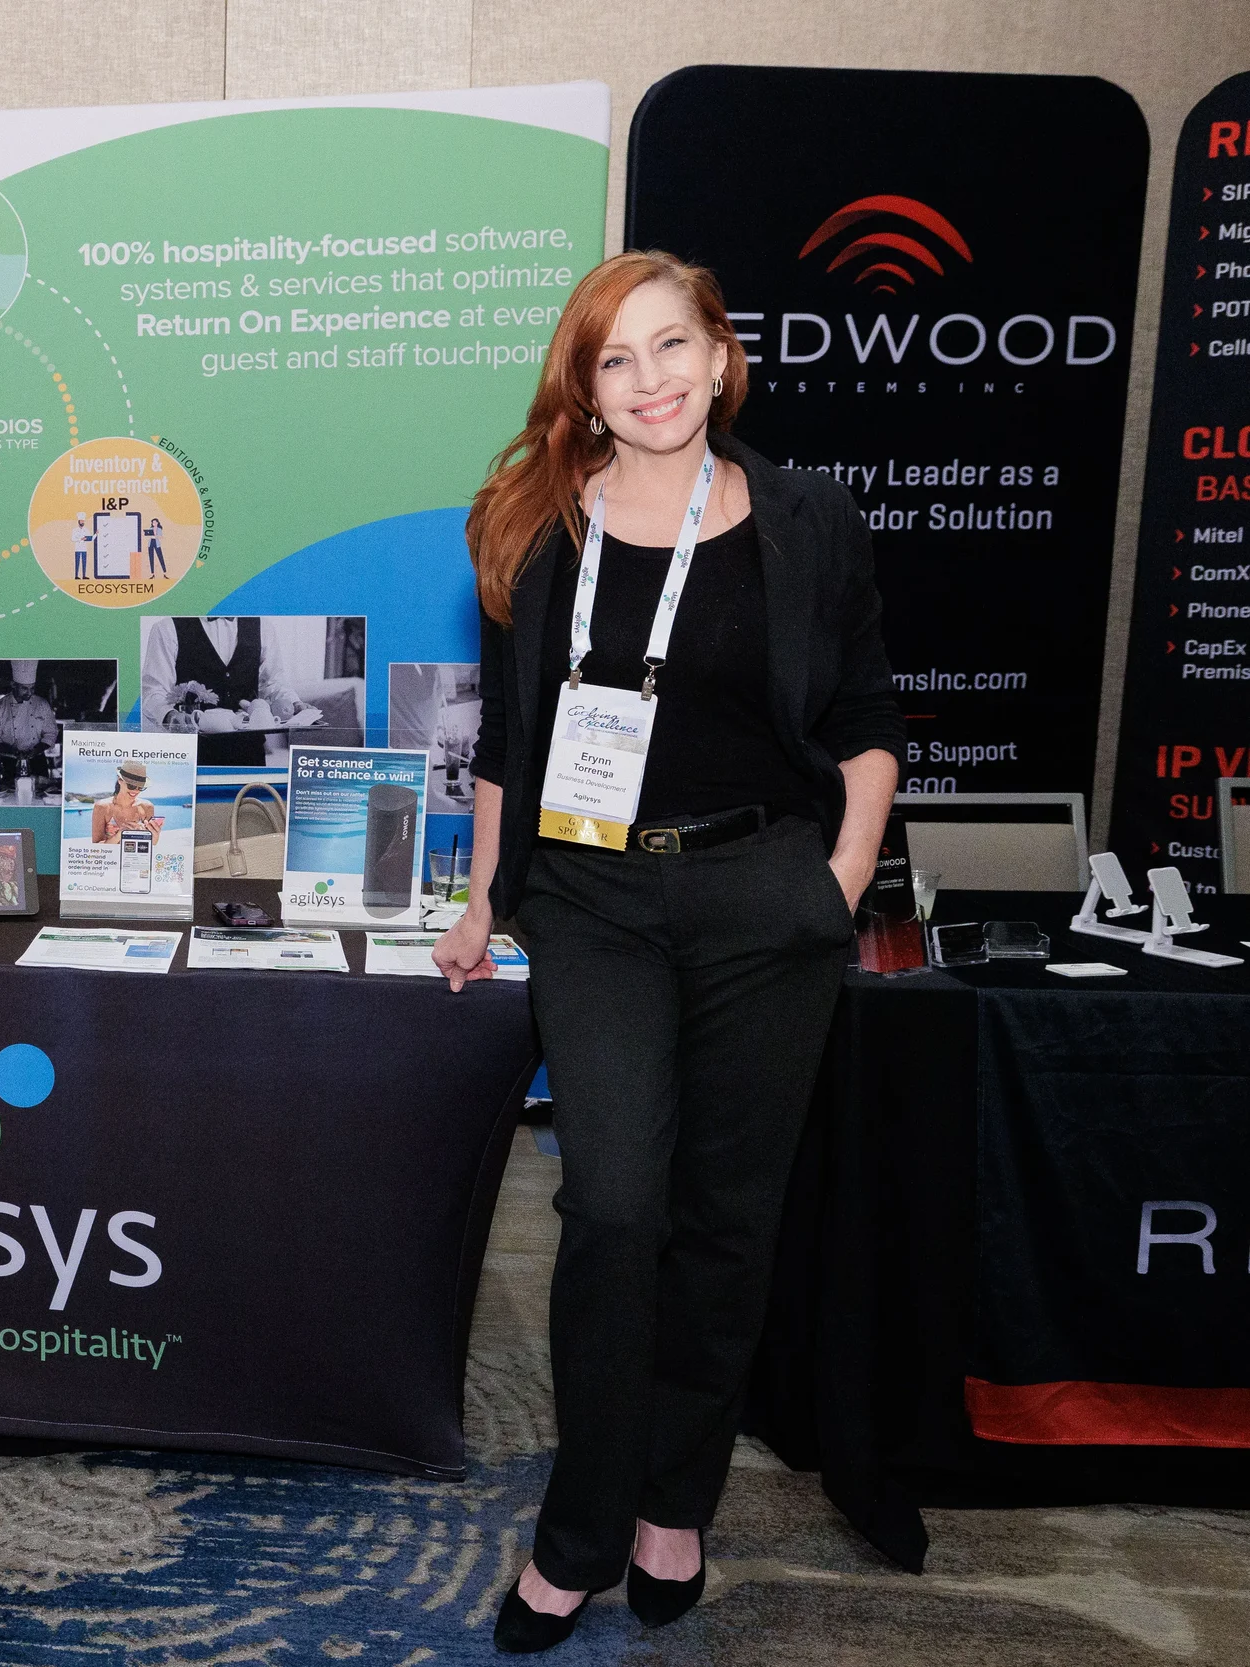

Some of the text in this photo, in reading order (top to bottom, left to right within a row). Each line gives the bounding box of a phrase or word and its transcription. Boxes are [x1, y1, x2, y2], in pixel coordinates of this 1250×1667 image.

[1208, 120, 1250, 158] R
[78, 226, 574, 268] 100% hospitality-focused software,
[120, 263, 572, 306] systems & services that optimize
[137, 313, 231, 336] Return
[239, 310, 281, 334] On
[291, 305, 451, 337] Experience
[459, 305, 485, 327] at
[201, 348, 279, 377] guest
[286, 345, 338, 369] and
[346, 343, 407, 367] staff
[960, 382, 1025, 393] INC
[6, 438, 38, 449] TYPE
[69, 453, 162, 477] Inventory &
[888, 459, 1059, 486] Leader as a
[63, 475, 169, 495] Procurement
[102, 497, 129, 510] I&P
[158, 437, 215, 560] EDITIONS & MODULES
[928, 503, 1053, 530] Solution
[1193, 527, 1244, 544] Mitel
[78, 583, 154, 594] ECOSYSTEM
[1187, 602, 1250, 619] Phone
[1184, 639, 1247, 659] CapEx
[892, 668, 1027, 692] msInc.com
[578, 717, 639, 734] Excellence
[71, 740, 106, 748] Maximize
[78, 748, 187, 760] Return On Experience
[298, 756, 373, 769] Get scanned
[581, 751, 612, 766] Erynn
[907, 741, 1018, 767] & Support
[1157, 745, 1250, 778] IP V
[297, 768, 414, 782] for a chance to win!
[573, 763, 614, 779] Torrenga
[557, 773, 627, 793] Business Development
[573, 792, 601, 804] Agilysys
[568, 817, 600, 830] GOLD
[558, 826, 608, 842] SPONSOR
[290, 892, 345, 907] agilysys
